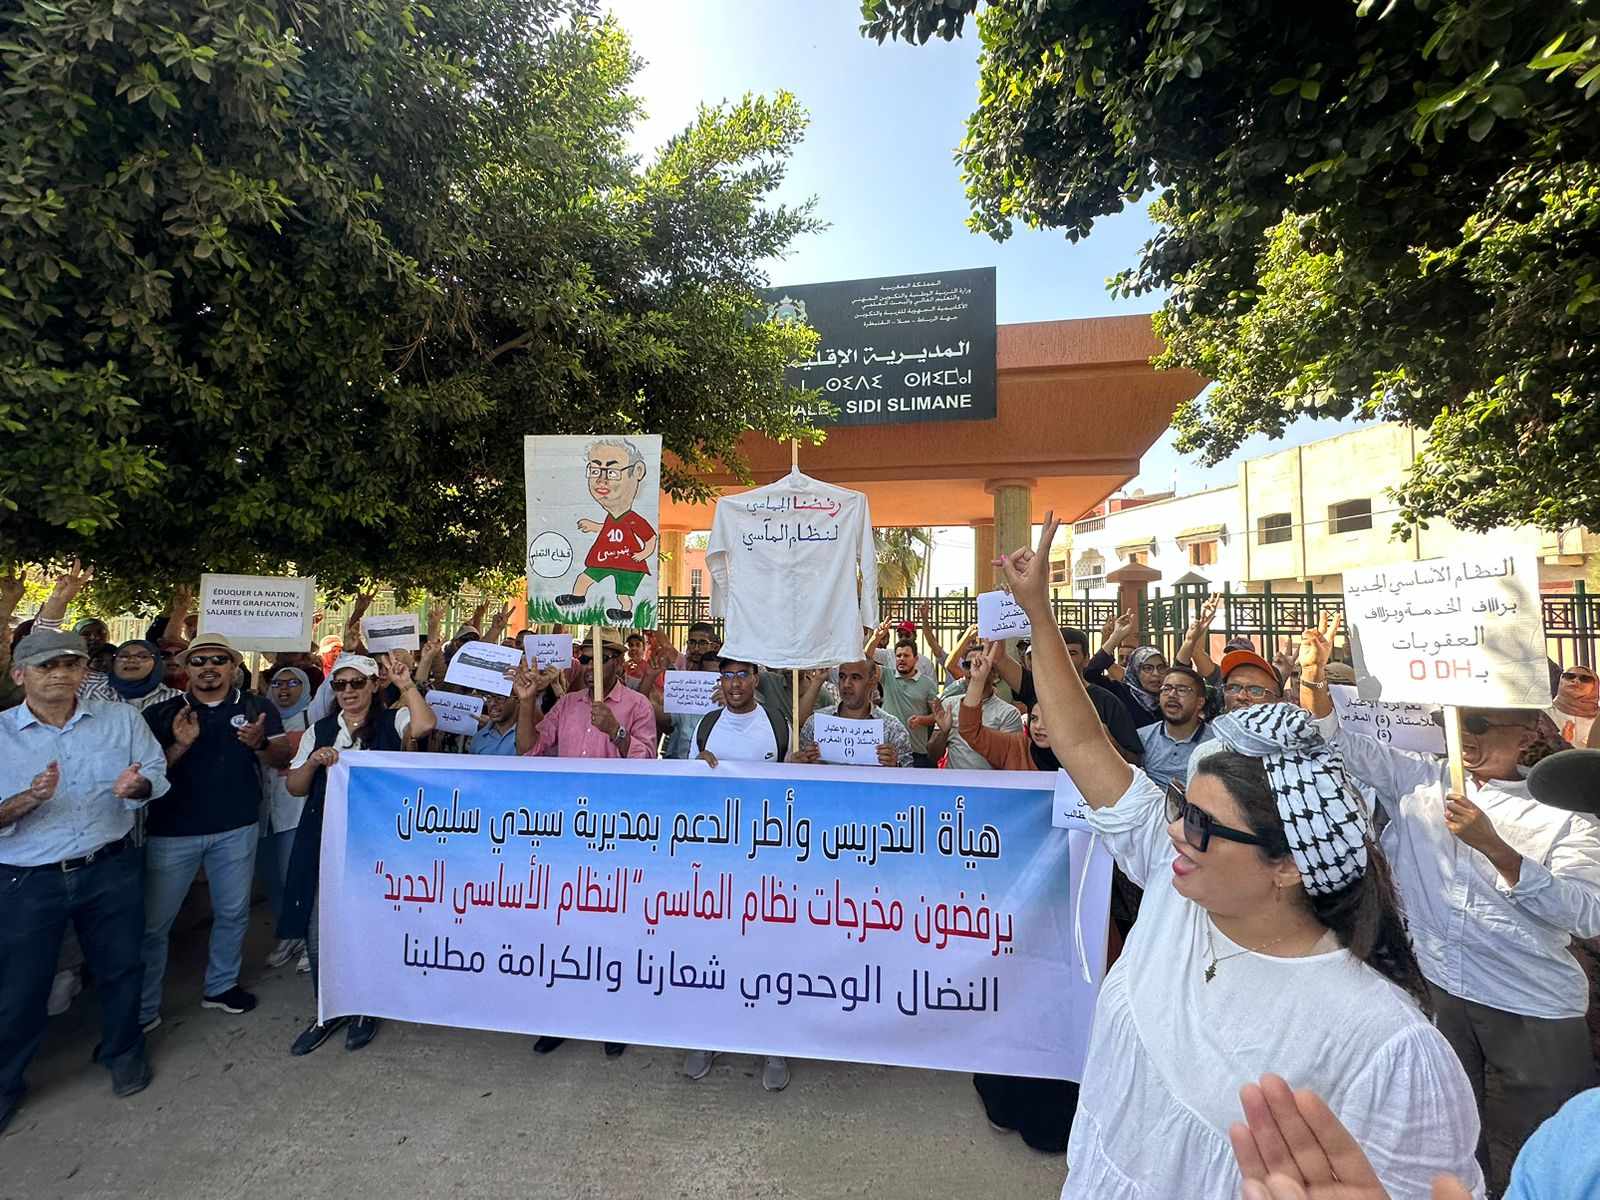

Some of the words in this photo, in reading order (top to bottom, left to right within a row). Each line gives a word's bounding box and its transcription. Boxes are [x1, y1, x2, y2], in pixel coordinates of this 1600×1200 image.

[863, 340, 971, 366] المديرية
[846, 399, 881, 414] SIDI
[887, 394, 972, 412] SLIMANE
[606, 528, 624, 543] 10
[786, 523, 839, 550] لنظام
[1347, 573, 1387, 597] الجديد
[1455, 556, 1515, 589] النظام
[206, 608, 242, 616] SALAIRES
[244, 609, 255, 617] EN
[1392, 625, 1485, 656] العقوبات
[397, 787, 480, 845] سليمان
[490, 808, 563, 855] سيدي
[574, 797, 660, 853] بمديرية
[670, 798, 740, 858] الدعم
[748, 789, 811, 862] وأطر
[822, 806, 925, 866] التدريس
[938, 796, 1001, 869] هيأة
[453, 853, 550, 925] الأساسي
[643, 861, 732, 936] المآسي
[741, 874, 797, 937] نظام
[808, 878, 903, 943] مخرجات
[914, 891, 1014, 957] يرفضون
[402, 931, 485, 977] مطلبنا
[498, 942, 622, 993] والكرامة
[636, 948, 726, 996] شعارنا
[739, 963, 882, 1012] الوحدوي
[897, 968, 999, 1017] النضال
